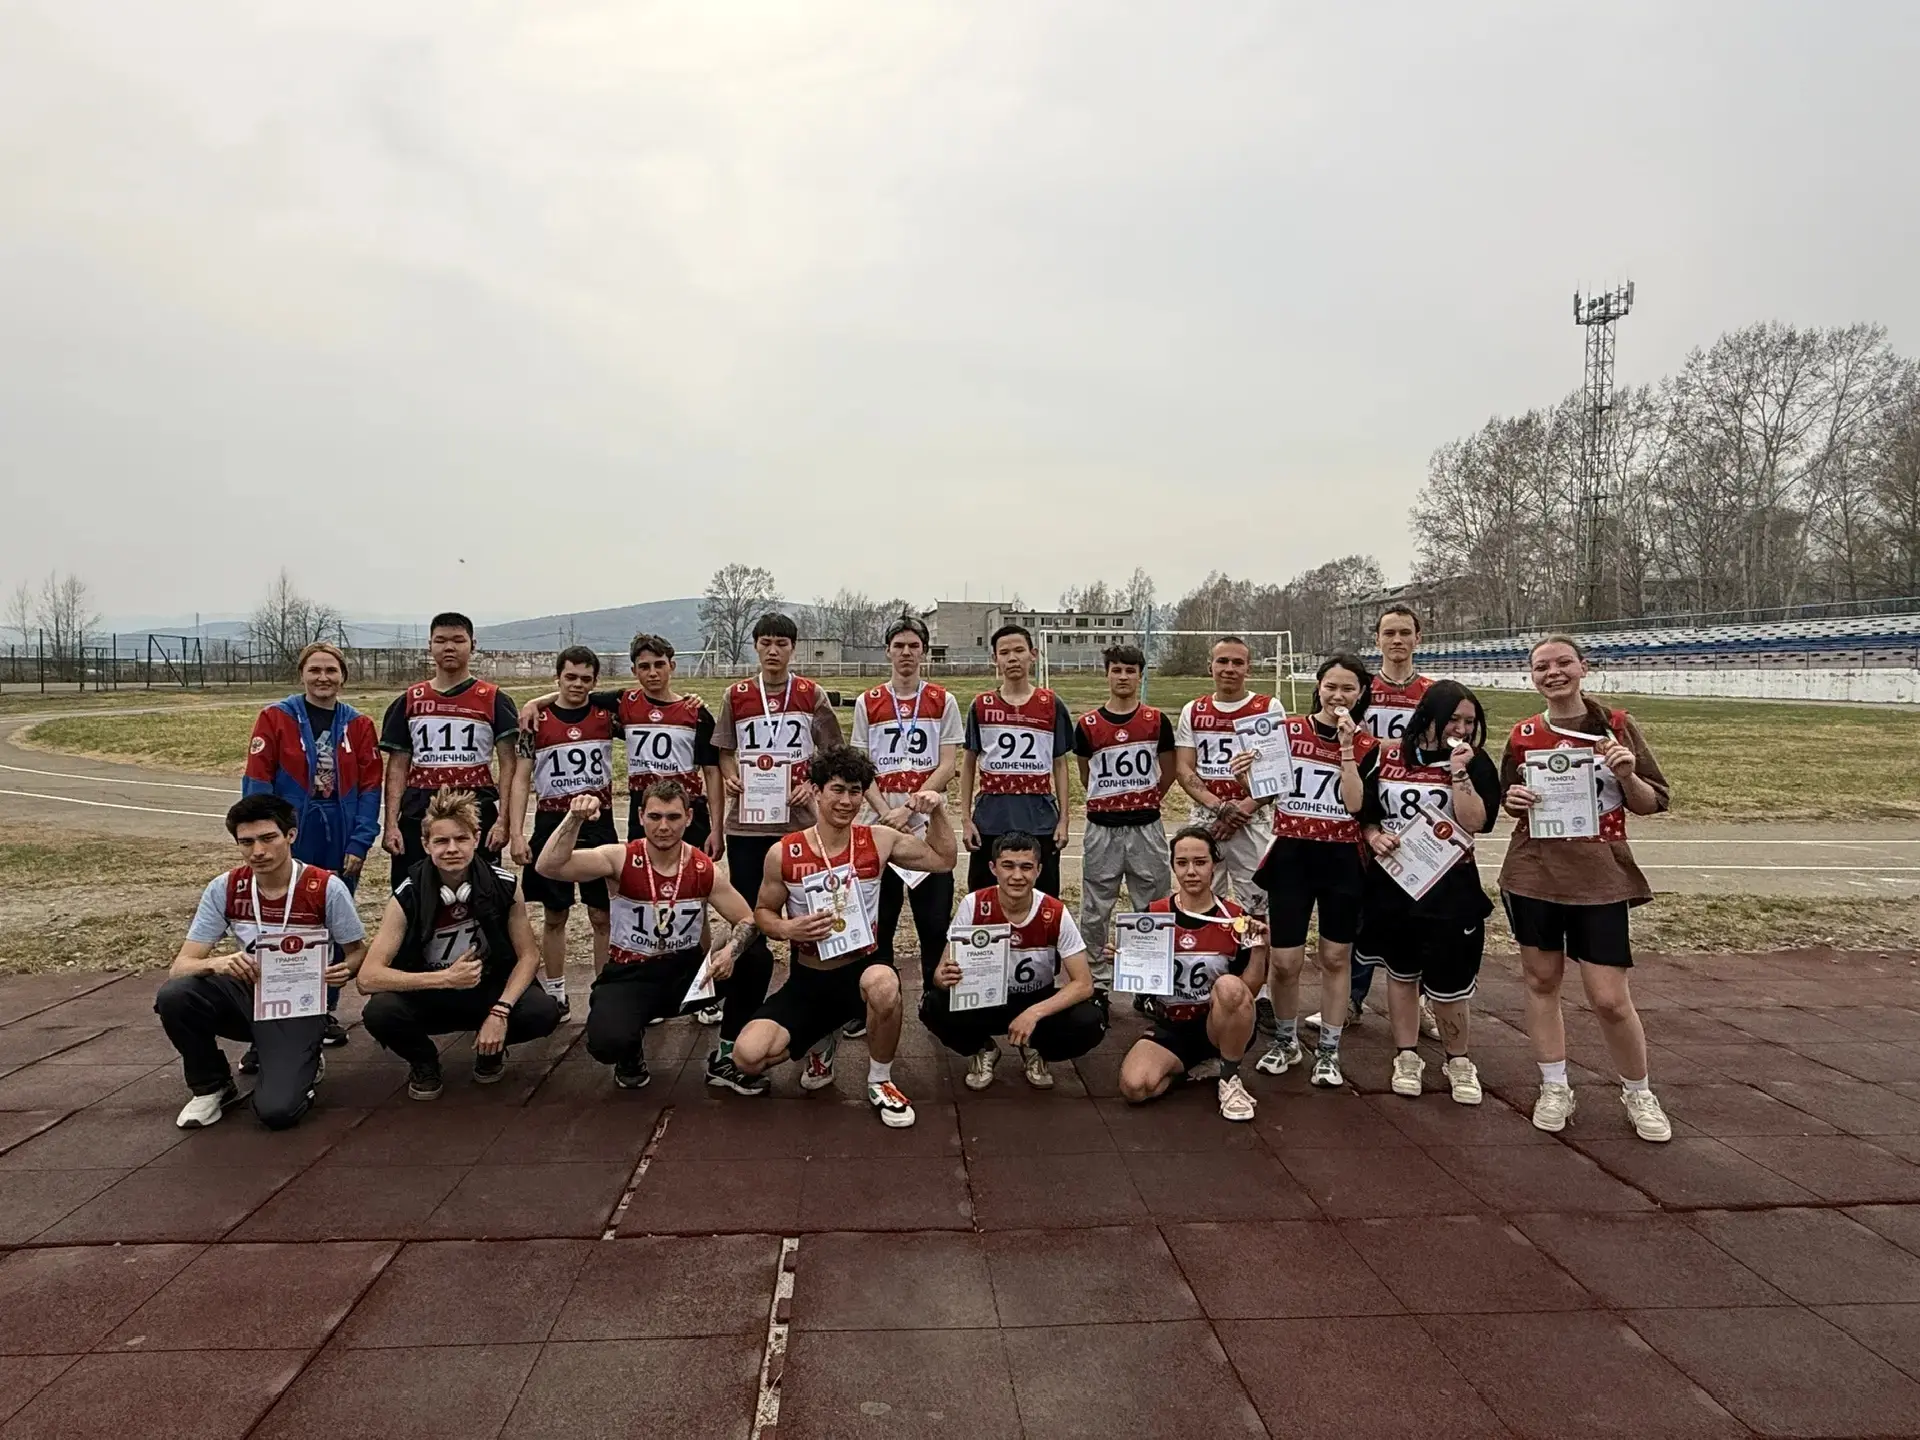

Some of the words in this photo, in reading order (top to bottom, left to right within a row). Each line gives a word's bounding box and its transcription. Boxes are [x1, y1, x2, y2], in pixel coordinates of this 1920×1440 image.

[985, 709, 1004, 721] ГТО
[1194, 715, 1214, 727] ГТО
[417, 723, 478, 752] 111
[632, 730, 672, 759] 70
[744, 720, 802, 749] 172
[884, 728, 928, 754] 79
[998, 733, 1036, 759] 92
[1291, 740, 1314, 755] ГТО
[548, 748, 603, 777] 198
[879, 756, 932, 767] СОЛННЫЙ
[1098, 749, 1152, 778] 160
[632, 905, 701, 938] 187
[630, 933, 692, 950] СОЛНЧНЫЙ
